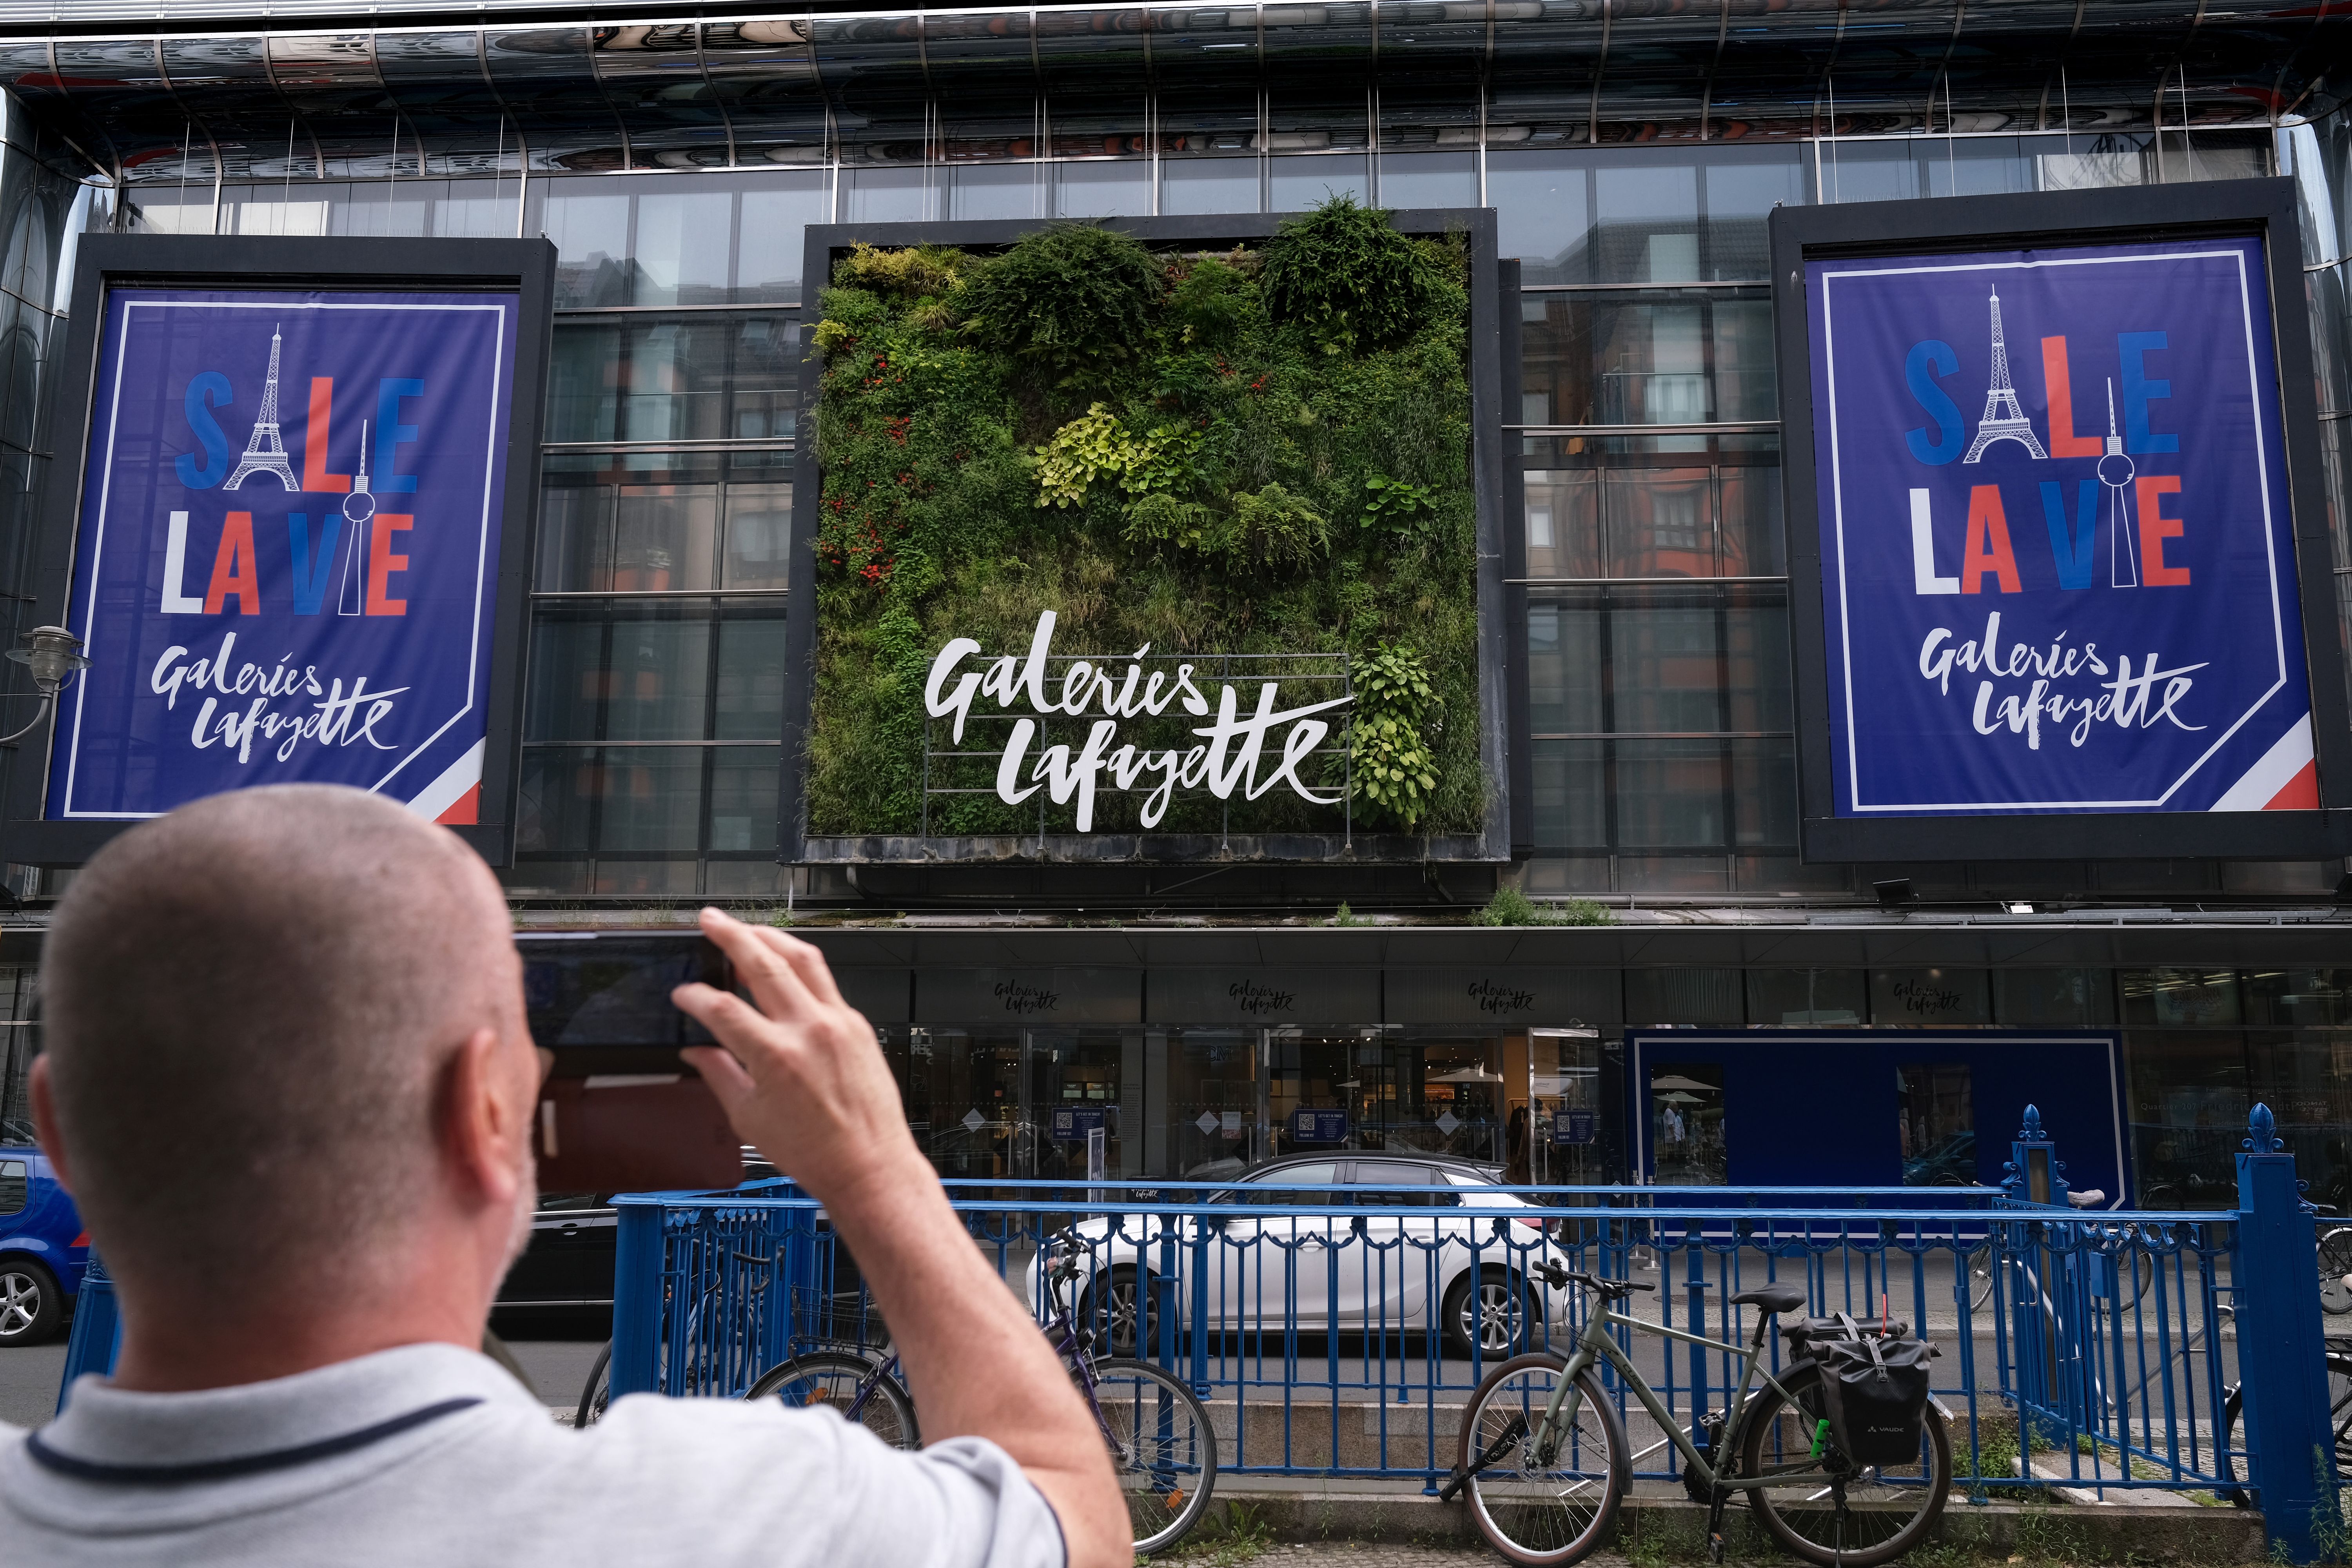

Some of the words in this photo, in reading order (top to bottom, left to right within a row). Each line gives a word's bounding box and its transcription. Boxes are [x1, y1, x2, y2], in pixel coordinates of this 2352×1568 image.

[1909, 485, 2022, 595] LA
[160, 511, 260, 615] LA
[1919, 611, 2108, 696] Galeries
[151, 632, 322, 710] Galeries
[925, 610, 1209, 746] Galeries
[1973, 652, 2210, 750] Lafayette
[192, 677, 410, 763] Lafayette
[996, 682, 1356, 832] Lafayette
[995, 978, 1038, 1000] Galeries
[1229, 979, 1273, 1000] Galeries
[1468, 978, 1513, 1000] Galeries
[1893, 979, 1940, 1001] Galeries
[1005, 991, 1061, 1014] Lafayette
[1241, 991, 1297, 1014] Lafayette
[1480, 991, 1537, 1014] Lafayette
[1907, 991, 1964, 1015] Lafayette
[2242, 1079, 2316, 1087] FredrichstadtPassagen
[1623, 1363, 1646, 1391] CUBE
